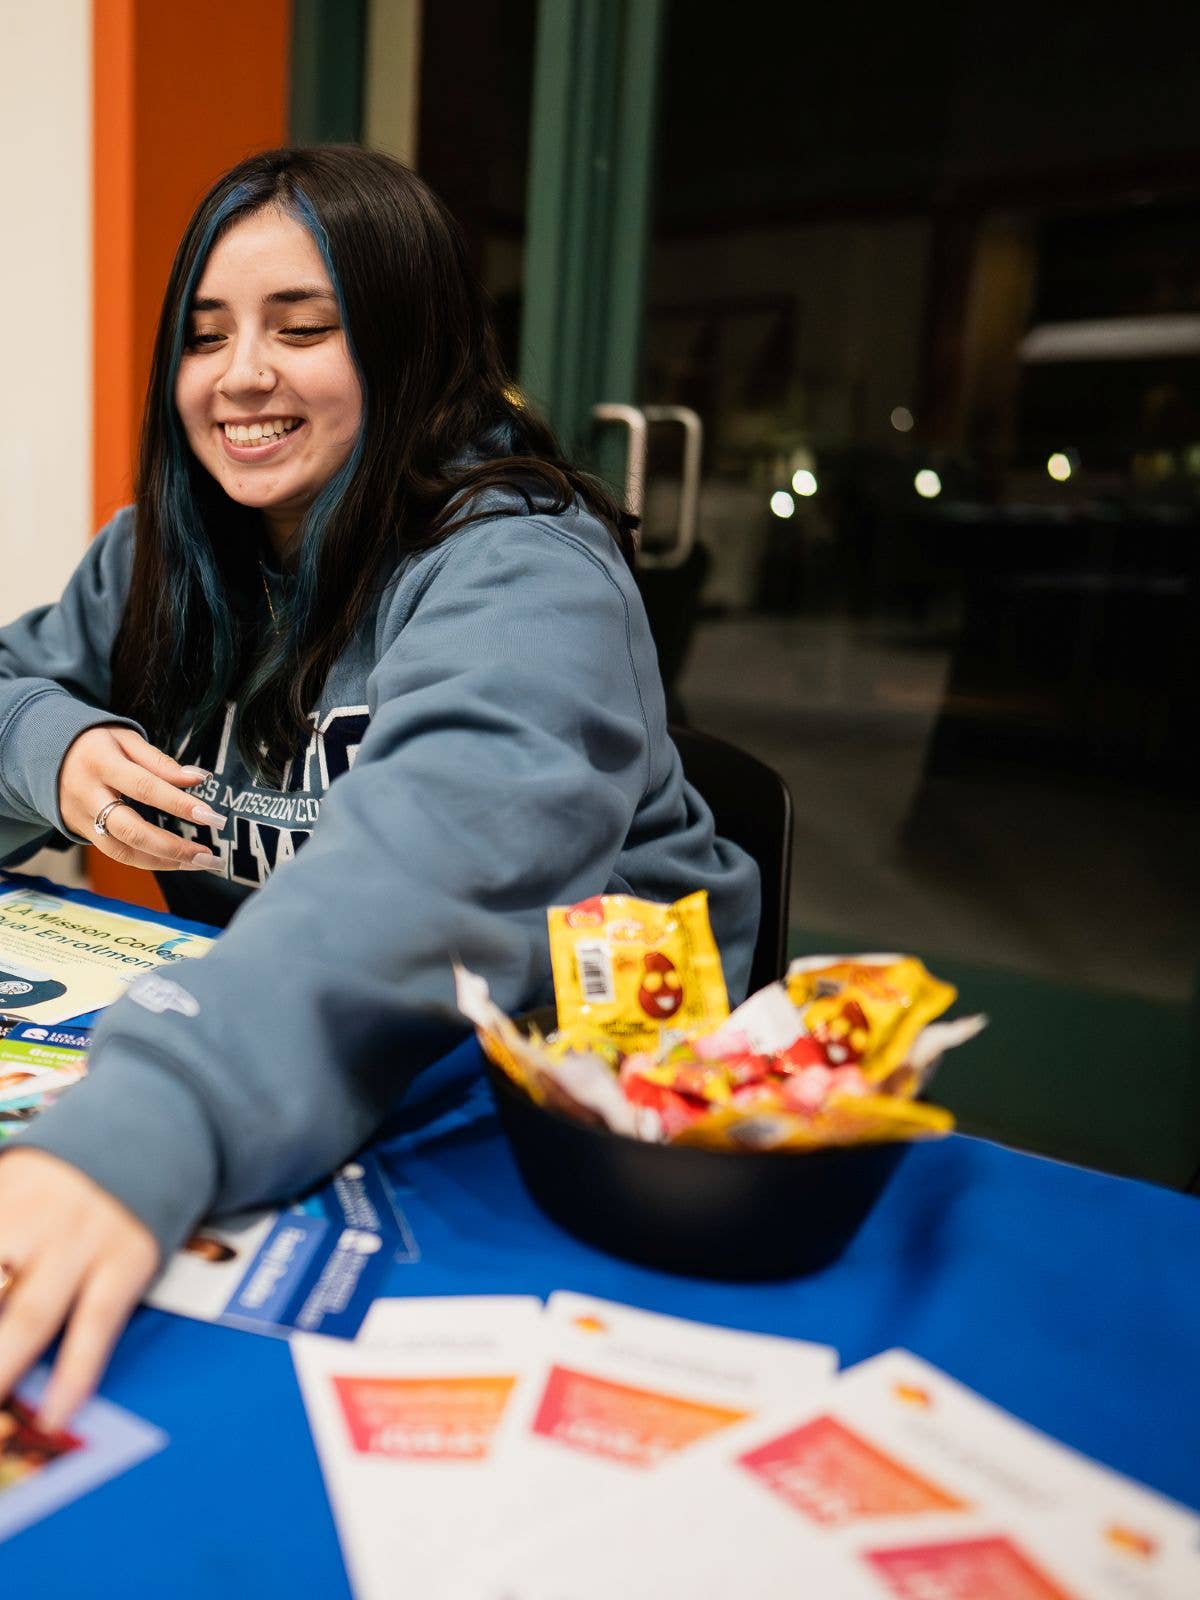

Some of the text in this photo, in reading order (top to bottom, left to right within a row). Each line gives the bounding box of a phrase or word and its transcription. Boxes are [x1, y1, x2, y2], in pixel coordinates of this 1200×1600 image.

[220, 785, 297, 821] MISSION
[2, 903, 35, 916] LA
[37, 911, 110, 939] Mission
[113, 936, 186, 962] Colleg
